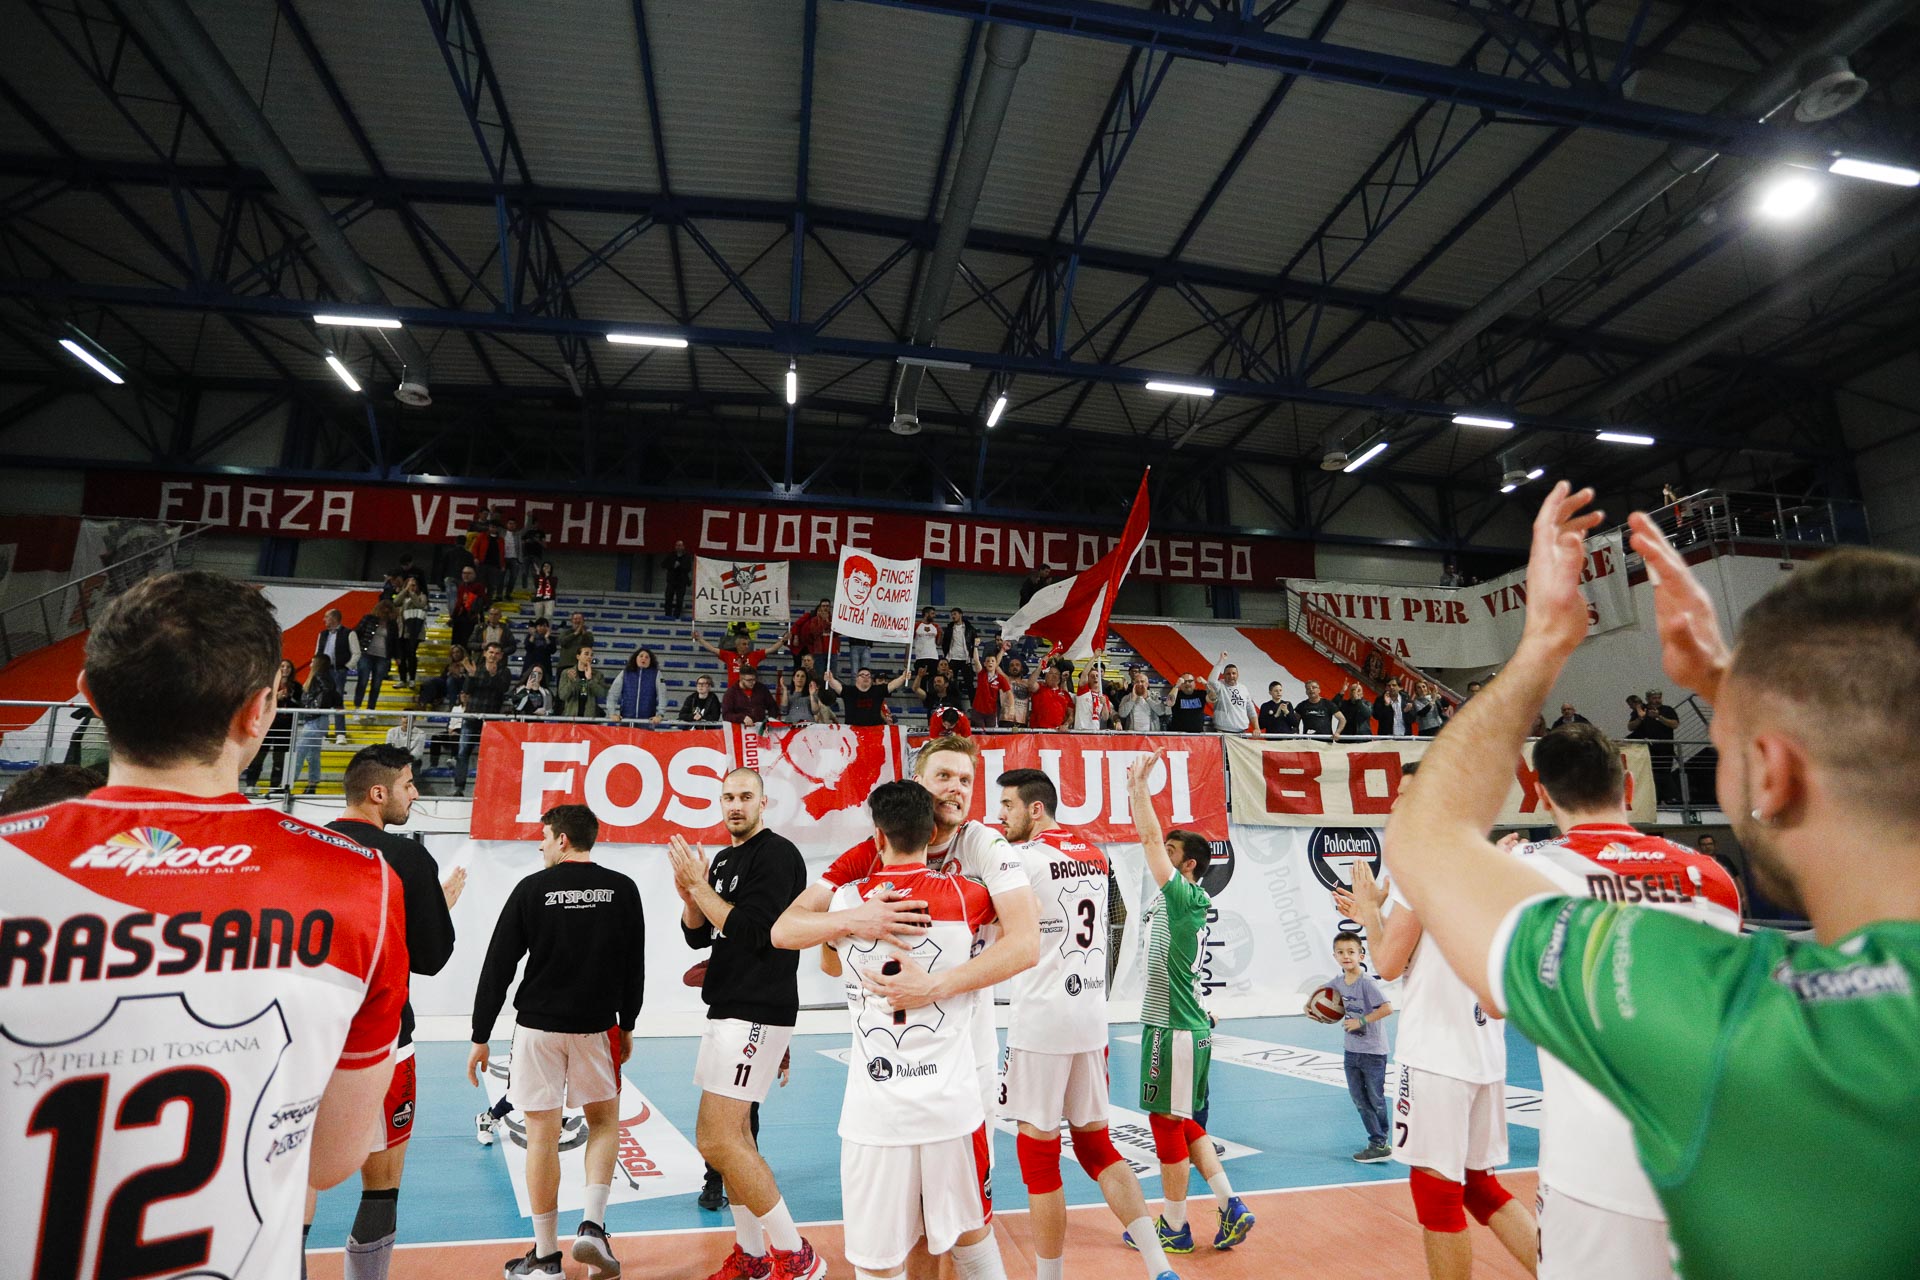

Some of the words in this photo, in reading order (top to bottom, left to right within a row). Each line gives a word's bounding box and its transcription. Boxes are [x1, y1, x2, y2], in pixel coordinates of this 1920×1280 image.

[158, 482, 354, 532] FORZA
[699, 509, 873, 554] CUORE
[709, 603, 770, 617] SEMPRE
[1298, 591, 1391, 621] UNITI
[1401, 597, 1469, 624] PER
[1308, 611, 1358, 662] VECCHIA
[1324, 832, 1371, 853] Polochem
[1076, 898, 1095, 949] 3
[0, 908, 335, 988] RASSANO
[62, 1048, 125, 1072] PELLE
[132, 1046, 155, 1065] DI
[163, 1036, 261, 1061] TOSCANA
[733, 1063, 752, 1088] 11
[1143, 1082, 1159, 1103] 17
[1395, 1120, 1409, 1148] 7
[26, 1064, 231, 1280] 12
